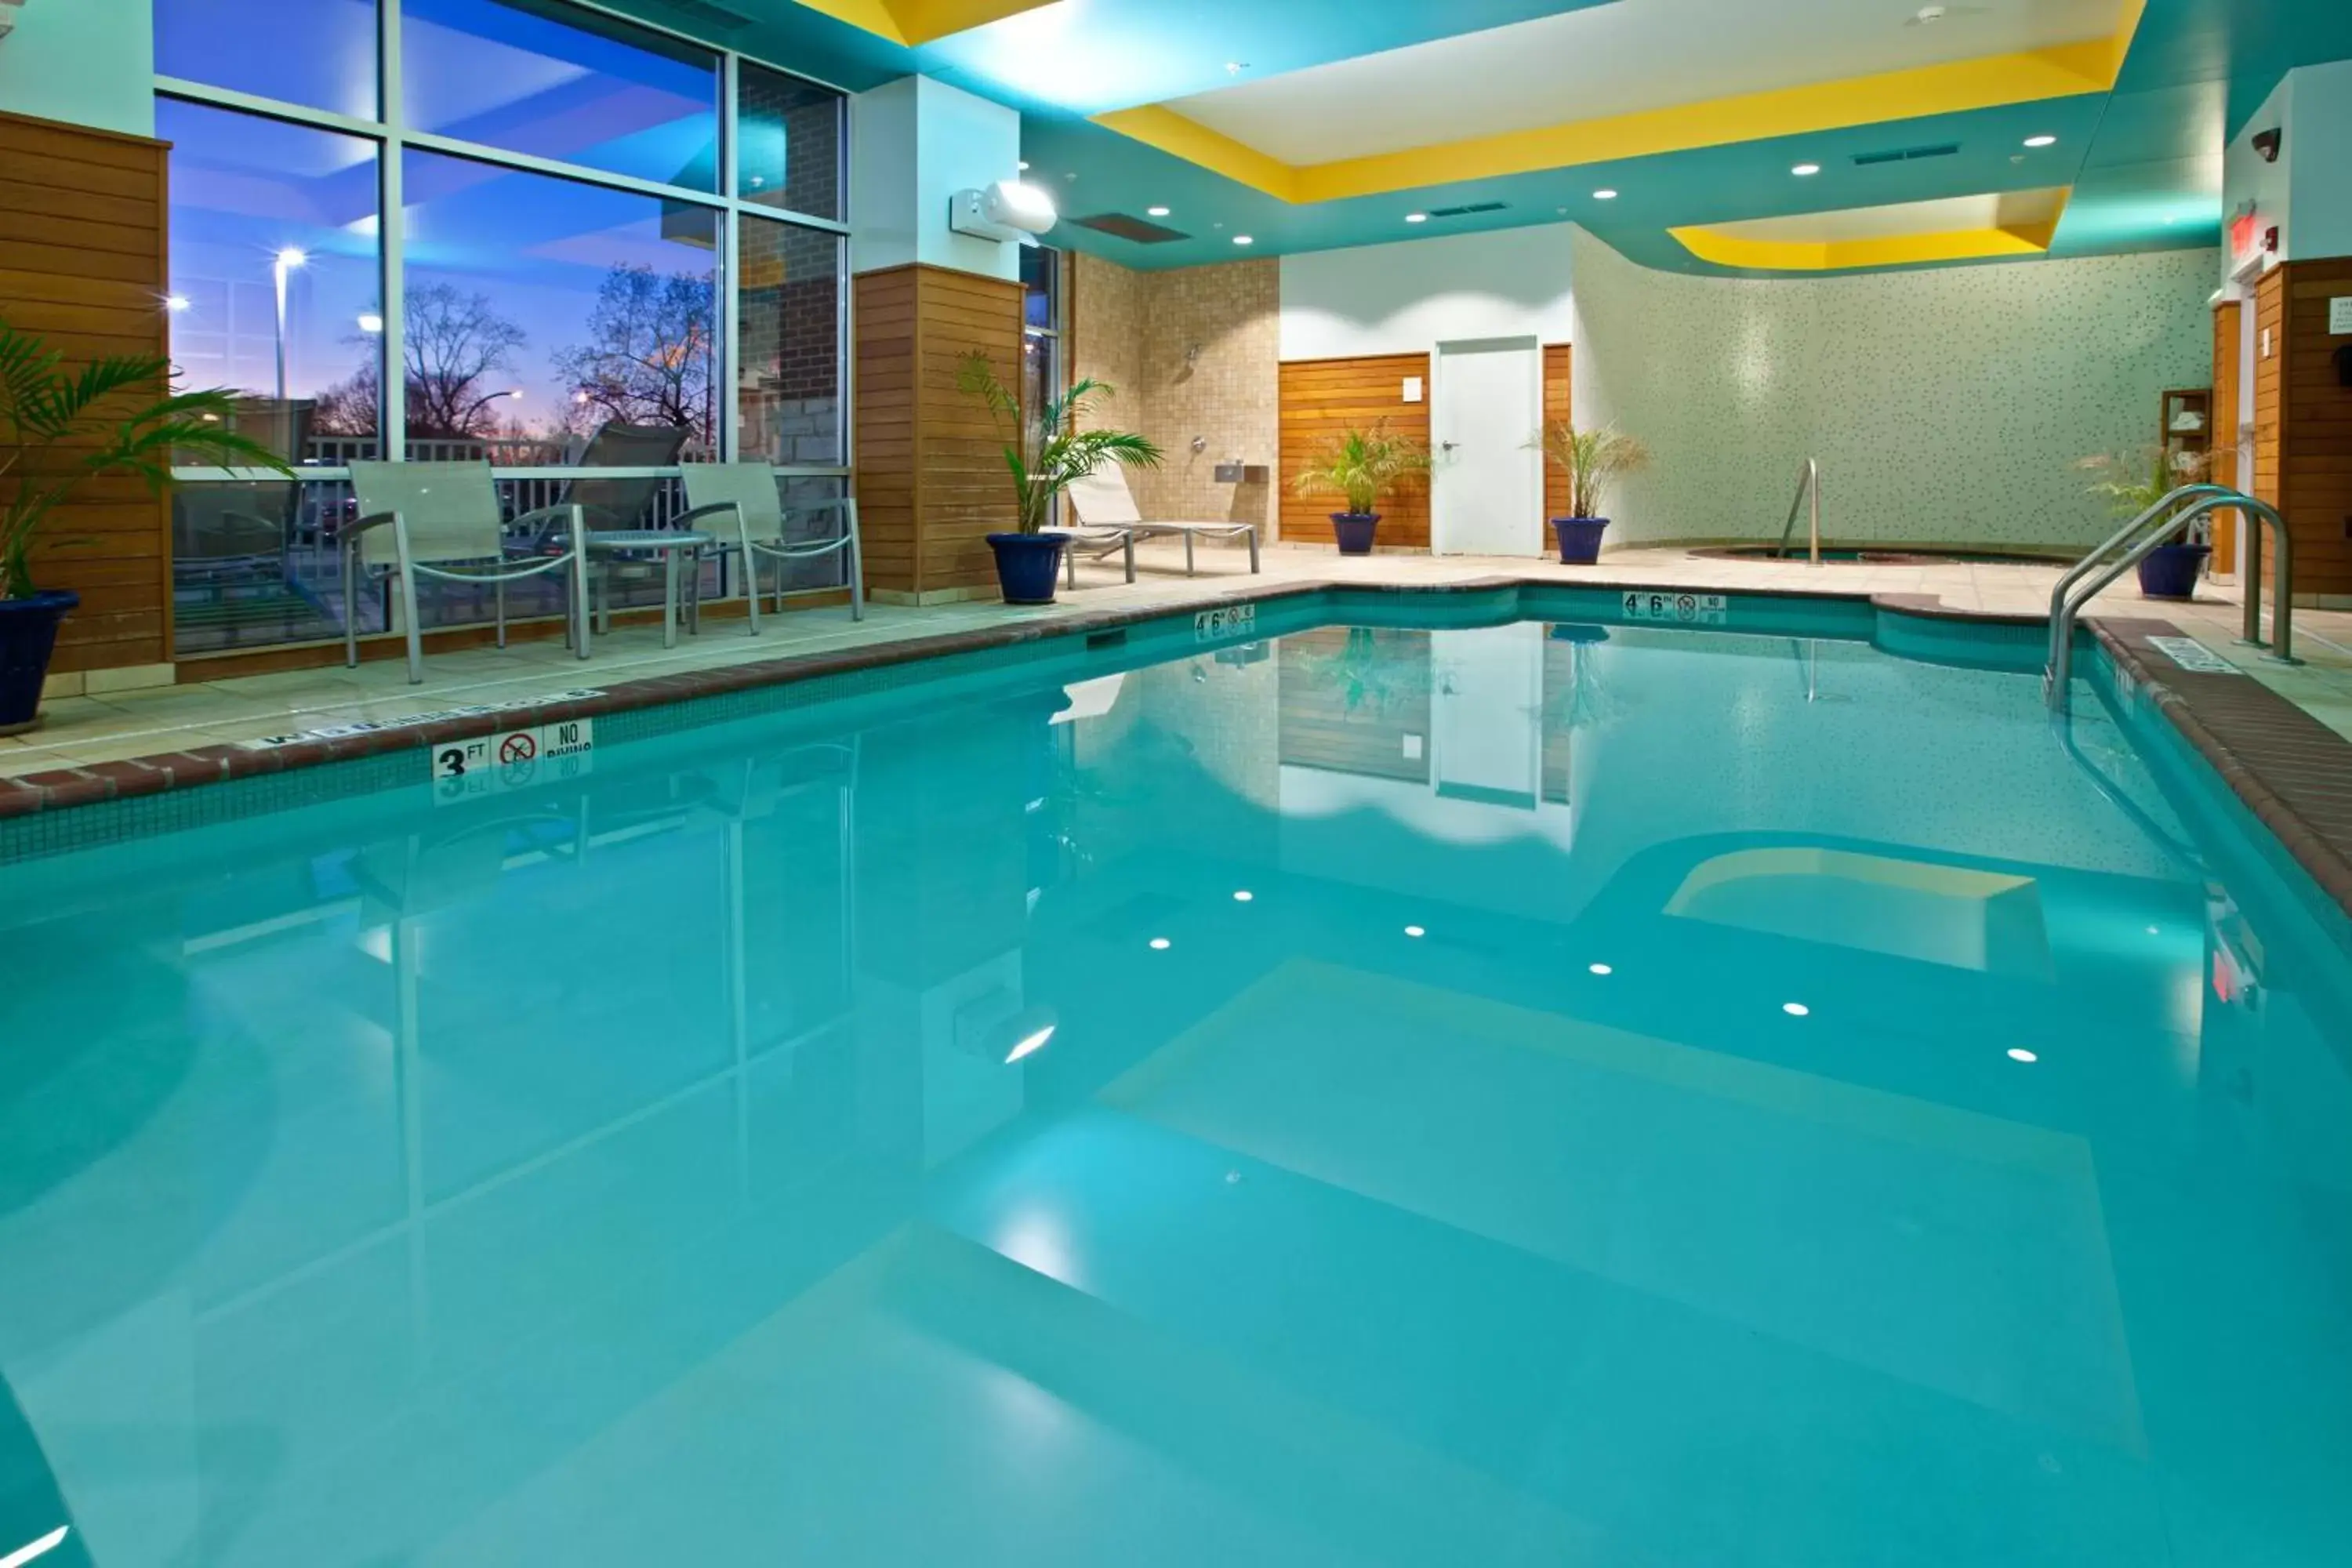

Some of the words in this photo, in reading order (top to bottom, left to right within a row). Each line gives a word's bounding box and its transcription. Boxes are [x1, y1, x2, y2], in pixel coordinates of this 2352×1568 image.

[1625, 593, 1636, 607] 4
[1650, 595, 1663, 612] 6
[559, 724, 579, 745] NO
[439, 749, 465, 778] 3
[467, 743, 485, 760] FT
